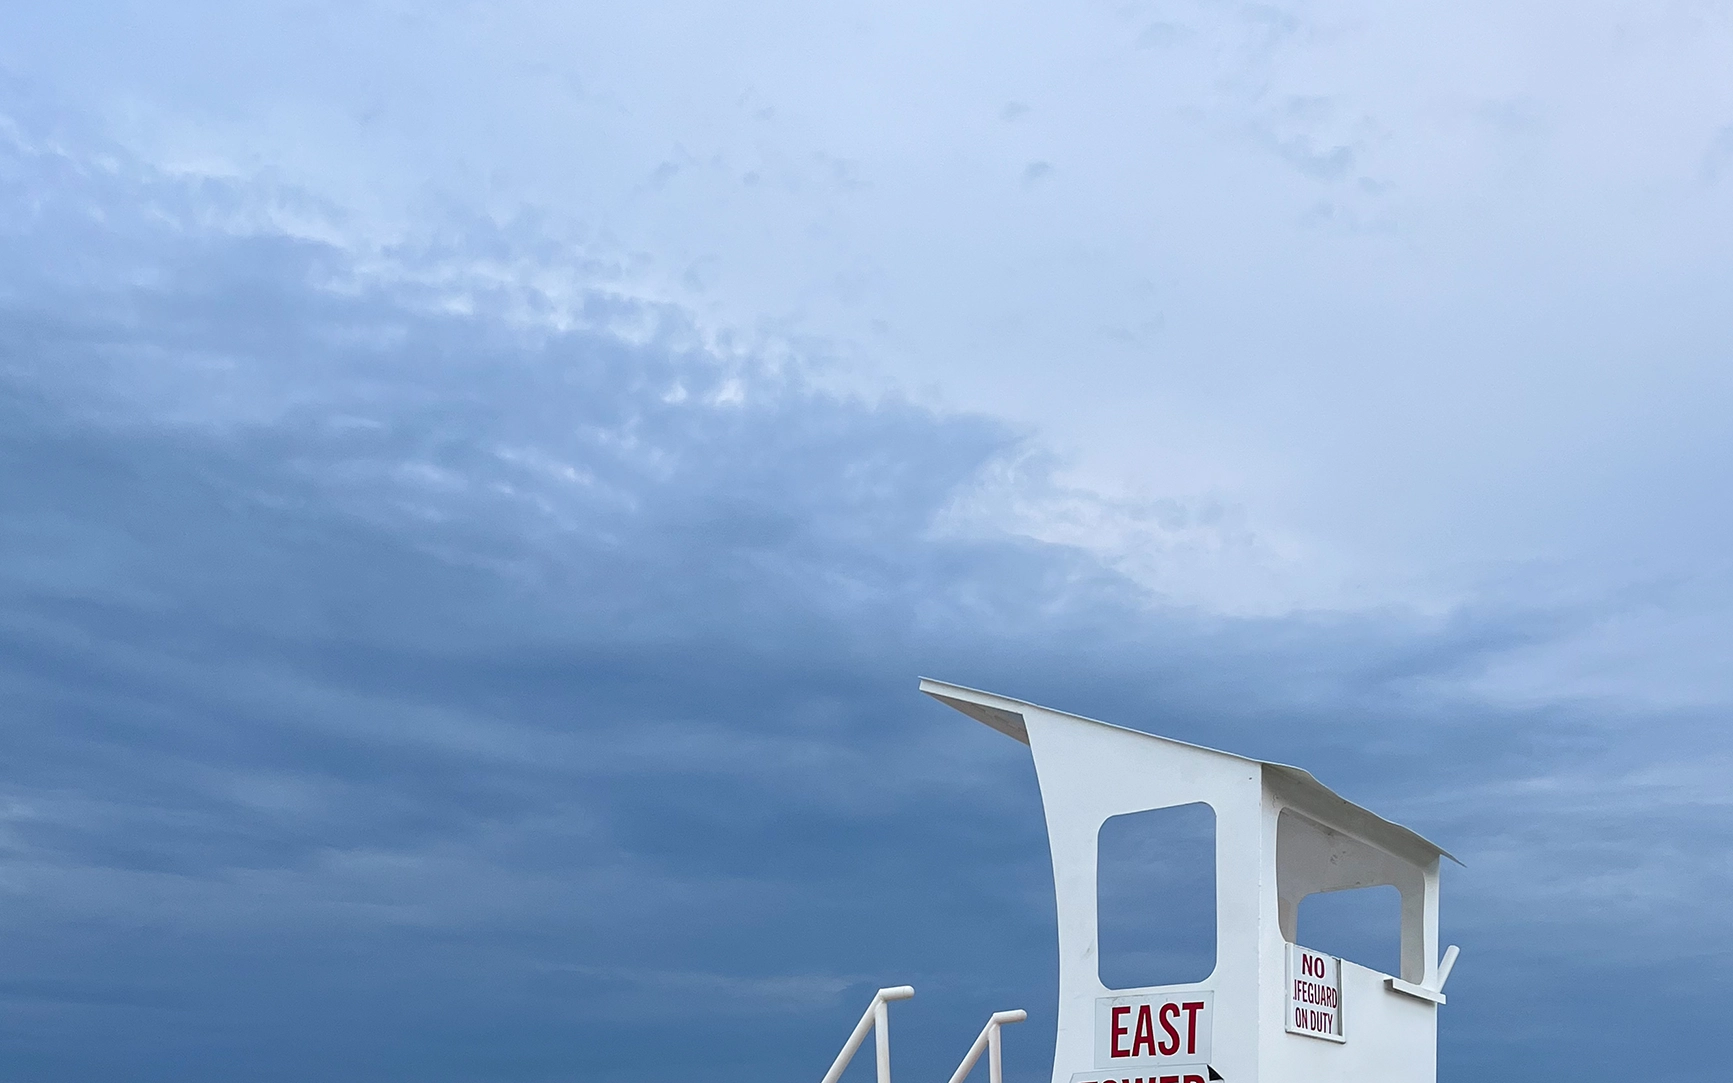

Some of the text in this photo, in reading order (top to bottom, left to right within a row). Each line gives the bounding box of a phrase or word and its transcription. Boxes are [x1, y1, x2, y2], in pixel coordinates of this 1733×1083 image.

[1302, 953, 1325, 979] NO
[1293, 979, 1338, 1009] IFEGUARD
[1110, 1001, 1205, 1058] EAST
[1295, 1007, 1334, 1034] ON DUTY
